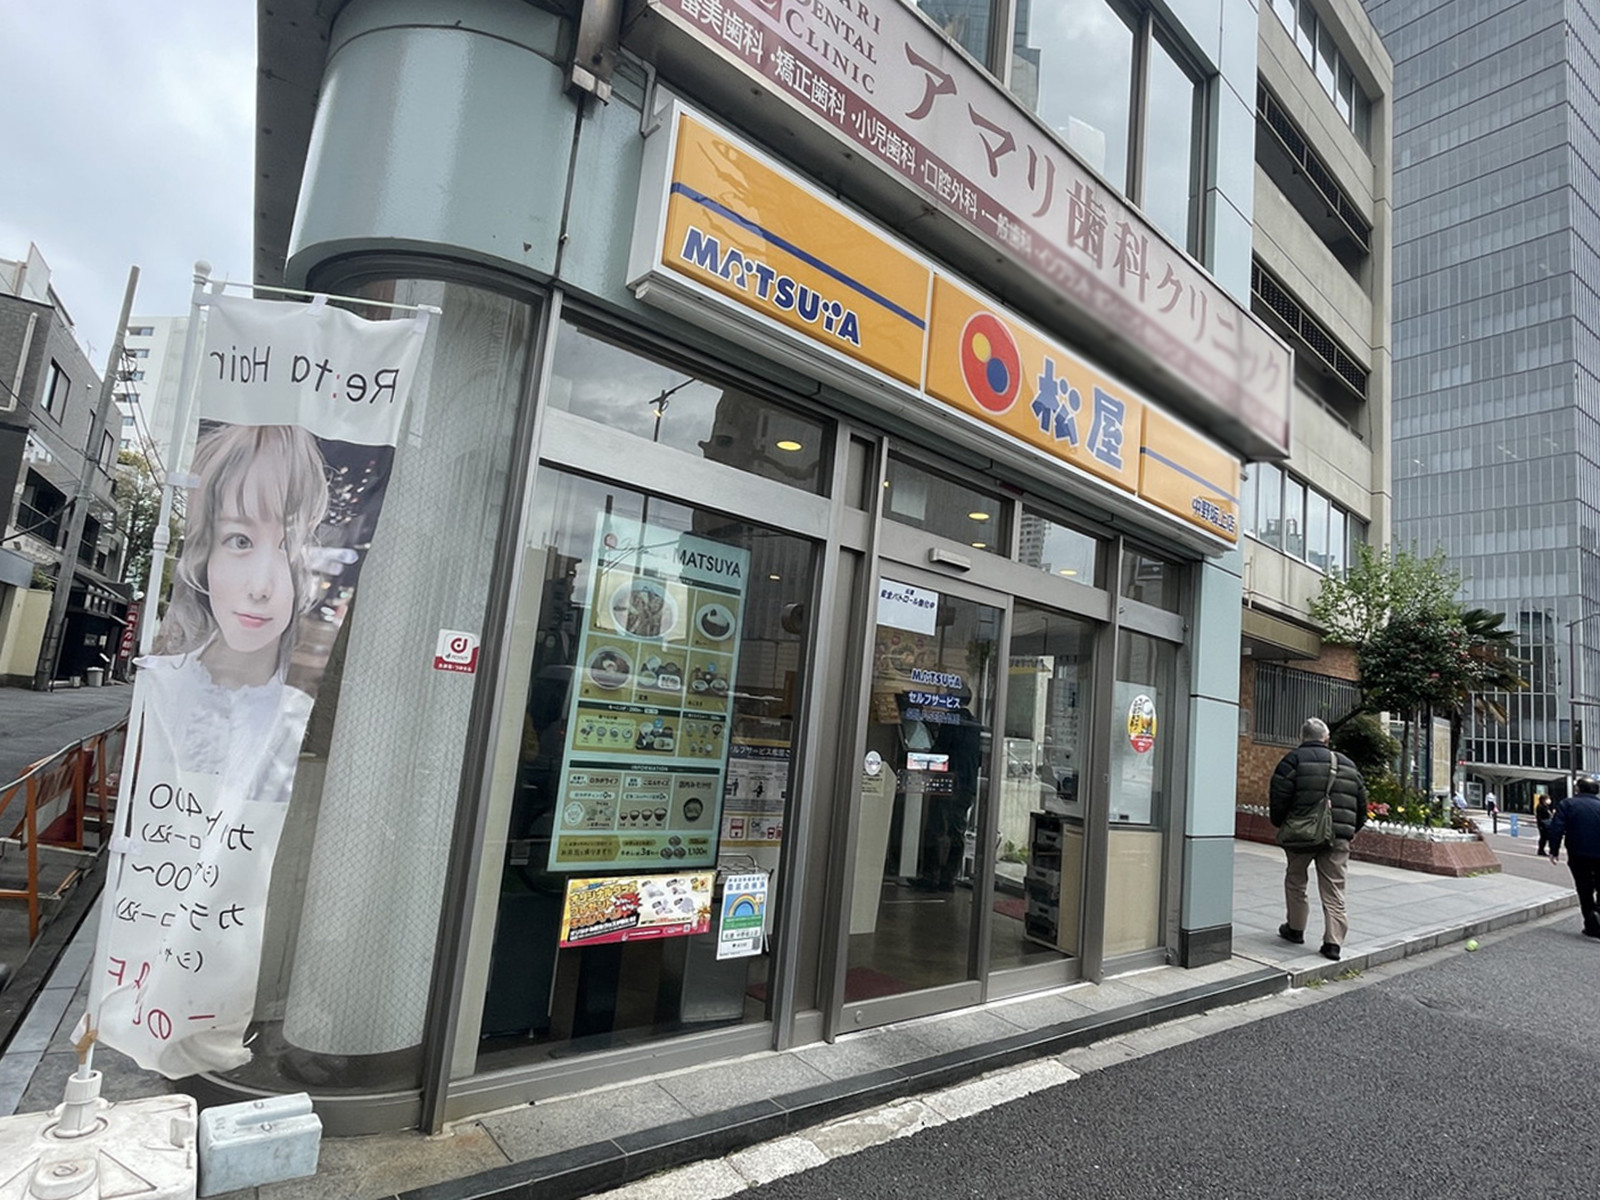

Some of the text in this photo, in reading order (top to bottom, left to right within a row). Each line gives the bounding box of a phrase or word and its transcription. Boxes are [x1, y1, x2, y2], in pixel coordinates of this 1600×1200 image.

[785, 8, 876, 95] CLINIC
[796, 0, 877, 65] ENTAL
[1029, 355, 1125, 473] 松屋
[1191, 497, 1236, 534] 中野坂上店
[673, 547, 742, 579] MATSUYA
[908, 691, 960, 709] セルフサービス
